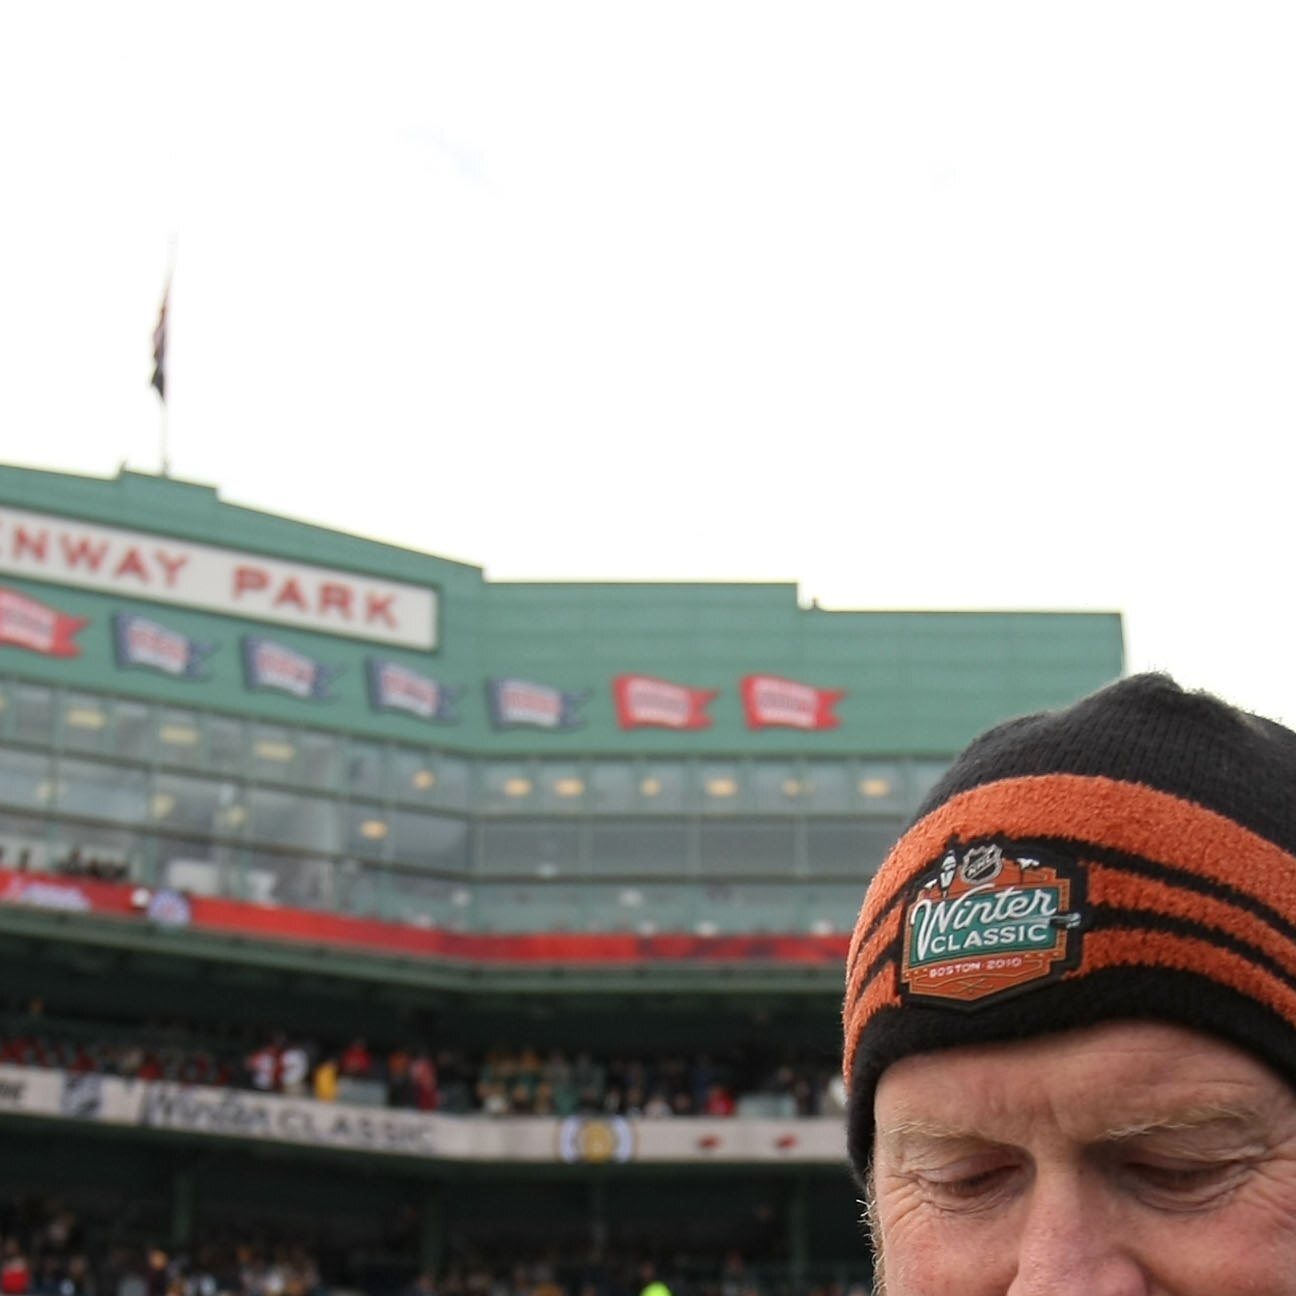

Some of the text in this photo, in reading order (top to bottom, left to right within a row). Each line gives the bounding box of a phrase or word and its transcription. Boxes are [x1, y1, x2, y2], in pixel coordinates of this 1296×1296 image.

[232, 565, 401, 630] PARK
[911, 884, 1057, 961] Winter
[930, 923, 1048, 953] CLASSIC
